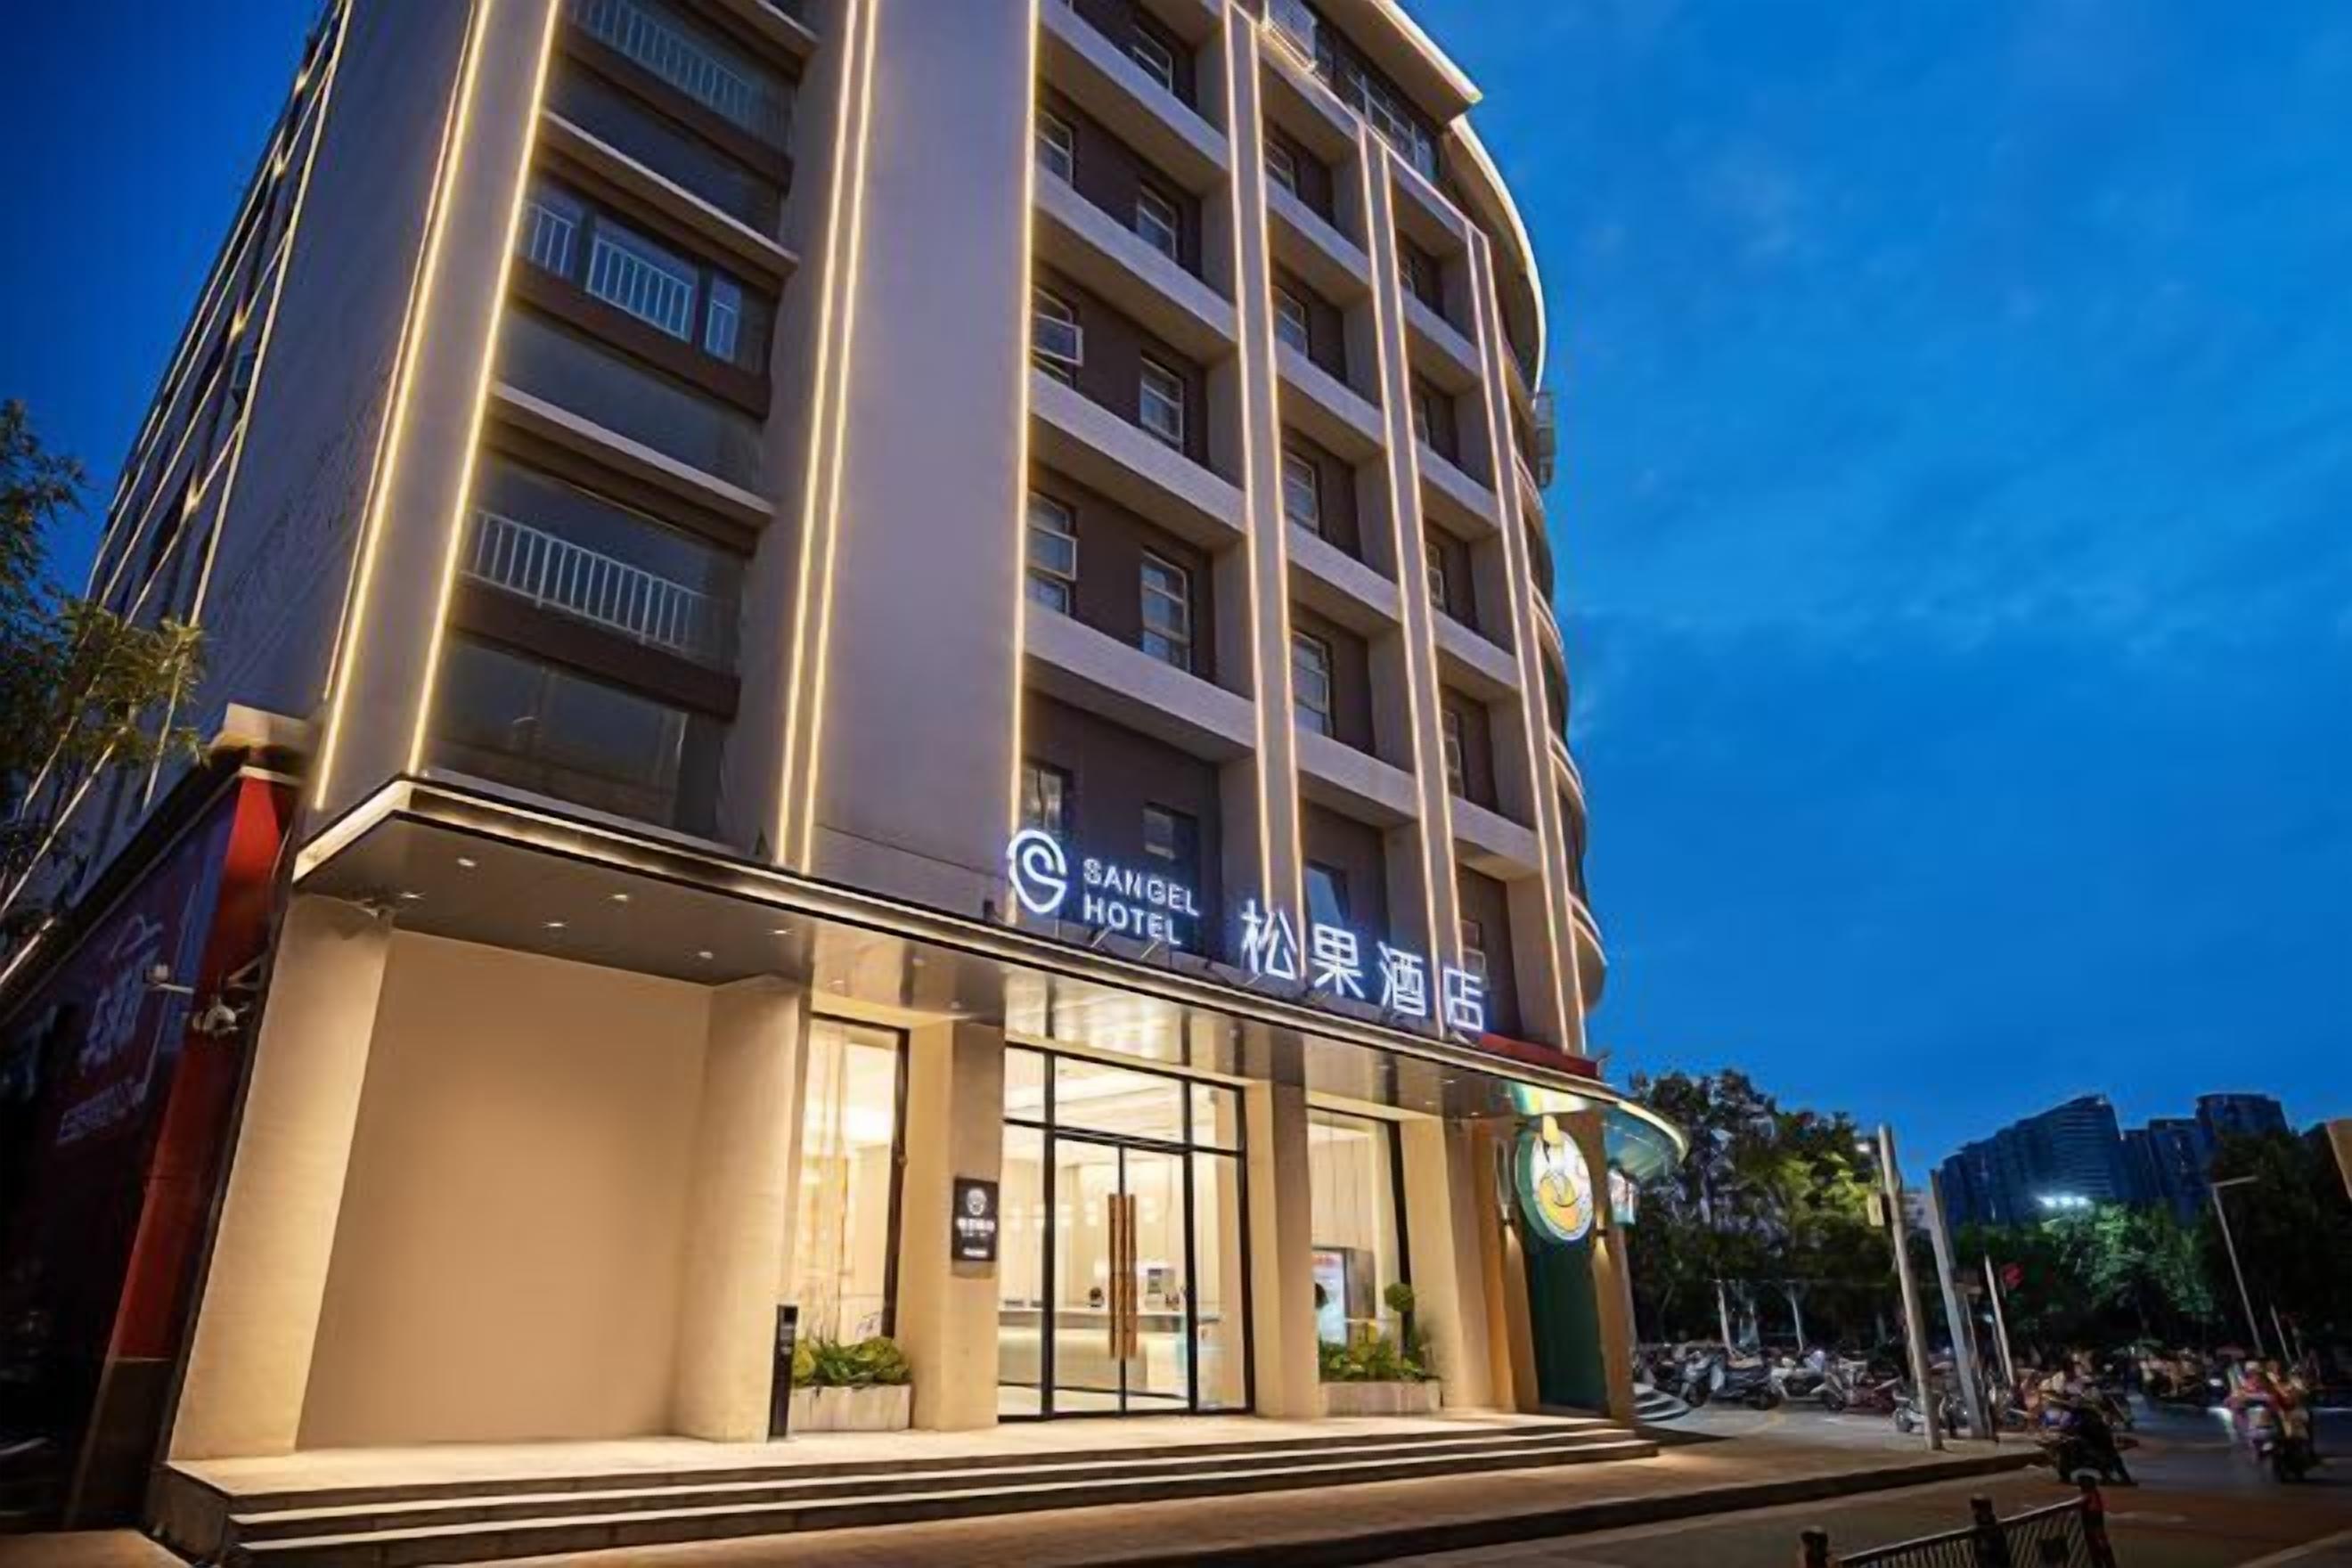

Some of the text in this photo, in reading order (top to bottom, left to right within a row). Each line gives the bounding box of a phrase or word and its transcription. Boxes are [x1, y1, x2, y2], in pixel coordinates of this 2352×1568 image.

[1083, 858, 1199, 917] SANGEL
[1083, 893, 1181, 945] HOTEL
[1241, 898, 1483, 1032] 松果酒店
